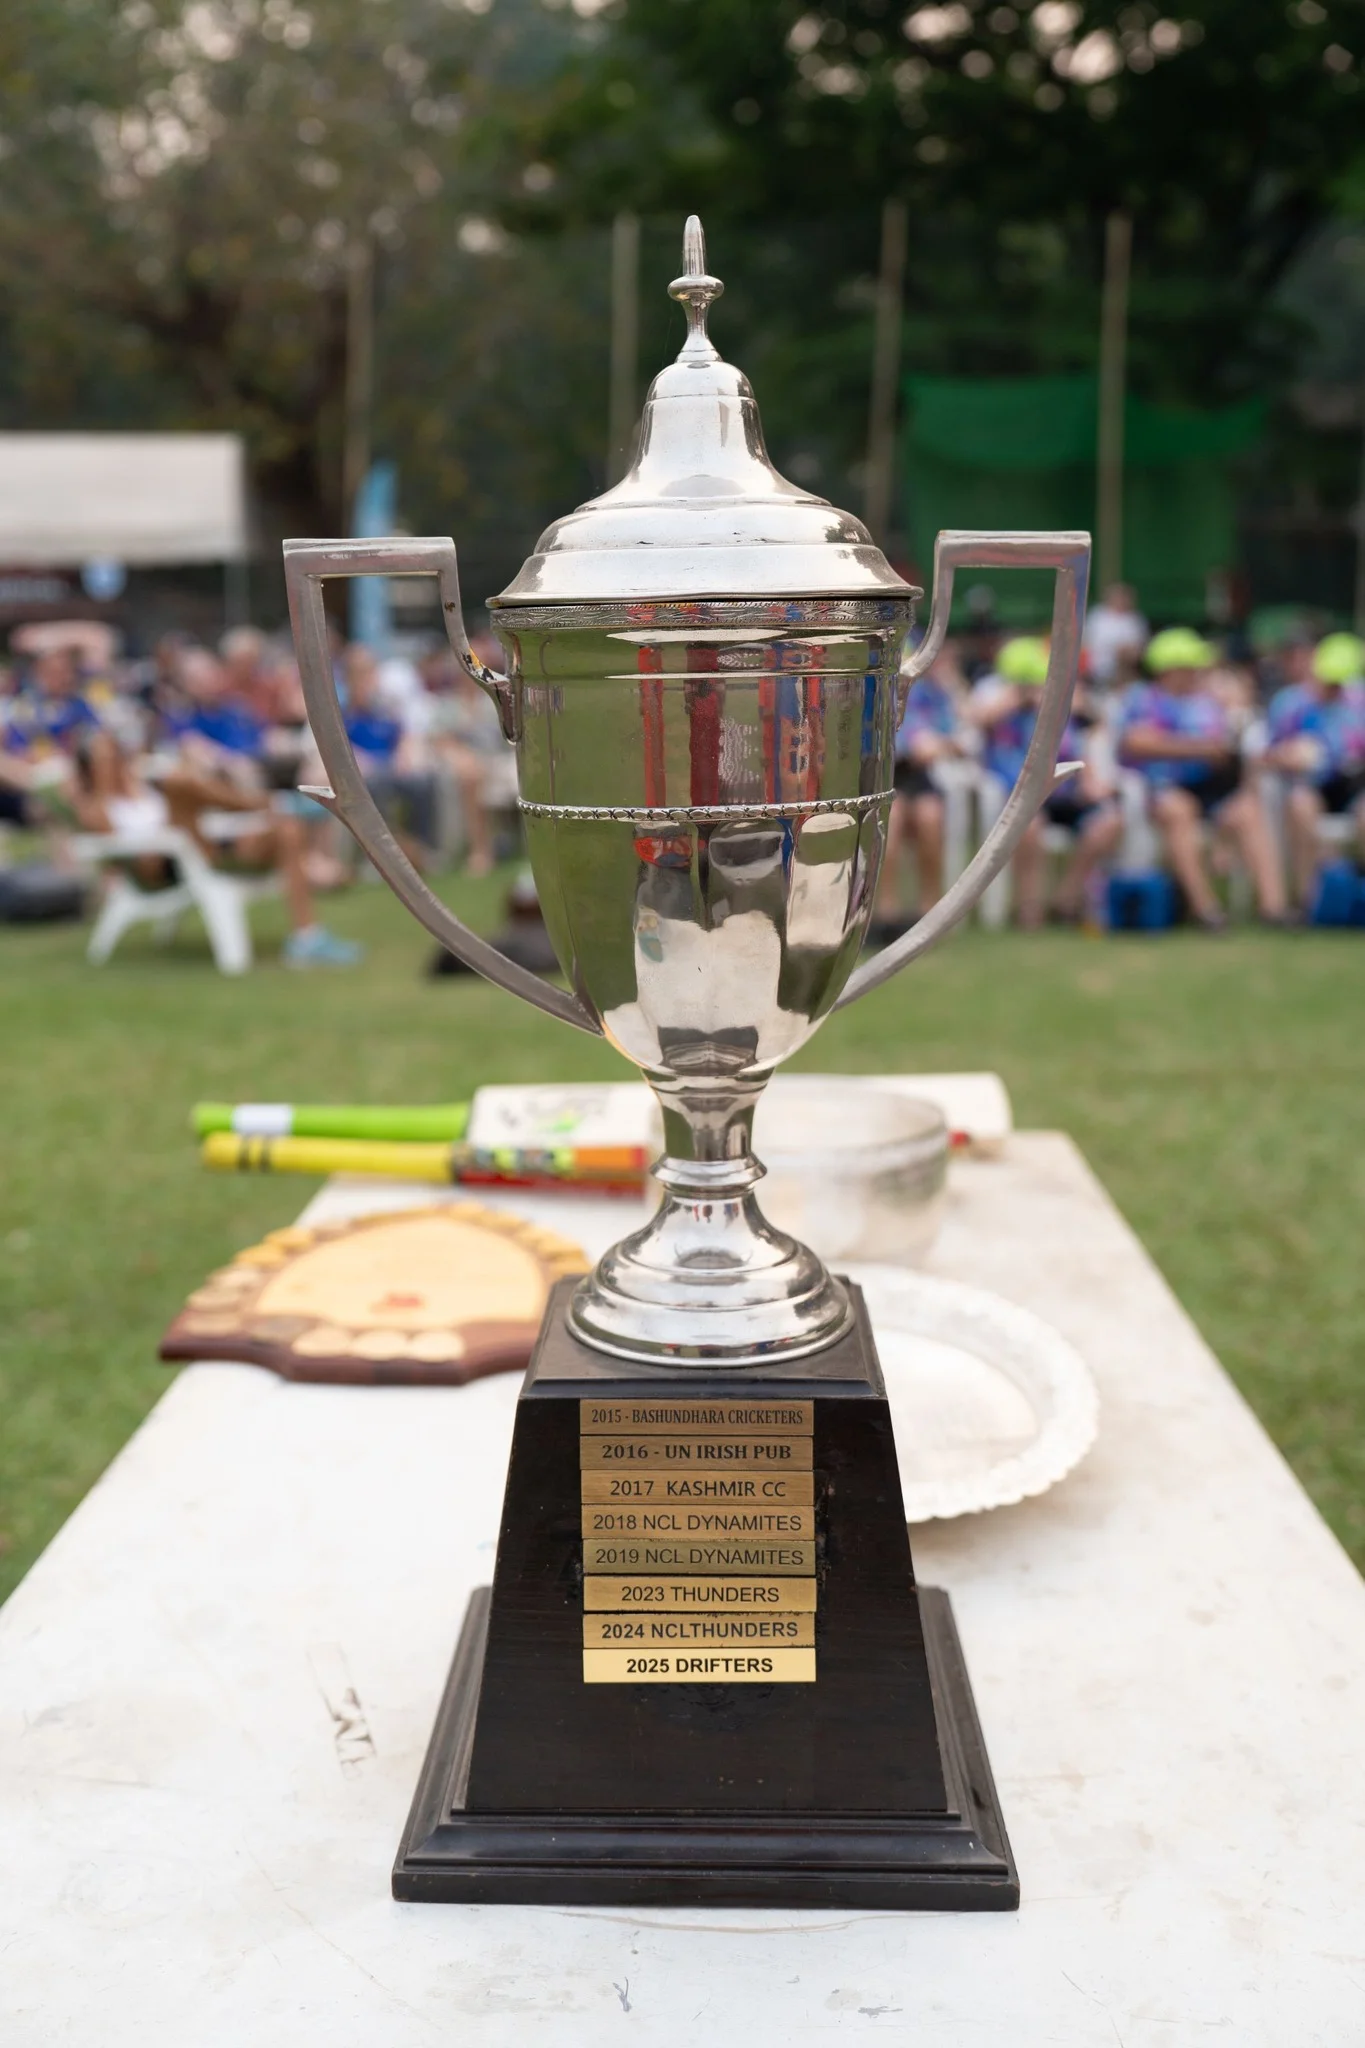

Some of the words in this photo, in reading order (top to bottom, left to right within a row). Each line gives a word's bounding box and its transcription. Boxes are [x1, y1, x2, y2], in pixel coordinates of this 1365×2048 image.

[591, 1409, 622, 1424] 2015
[632, 1409, 726, 1424] BASHUNDHARA
[727, 1410, 803, 1424] CRICKETERS
[602, 1445, 649, 1459] 2016
[665, 1445, 691, 1459] UN
[696, 1445, 748, 1459] IRISH
[753, 1445, 791, 1459] PUB
[610, 1480, 654, 1496] 2017
[667, 1481, 756, 1497] KASHMIR
[762, 1481, 786, 1497] CC
[593, 1514, 637, 1530] 2018
[643, 1514, 682, 1530] NCL
[687, 1515, 802, 1531] DYNAMITES
[595, 1548, 639, 1564] 2019
[645, 1548, 684, 1564] NCL
[689, 1549, 804, 1565] DYNAMITES
[621, 1586, 665, 1601] 2023
[670, 1586, 779, 1602] THUNDERS
[601, 1623, 645, 1639] 2024
[626, 1658, 670, 1673] 2025
[675, 1657, 773, 1673] DRIFTERS
